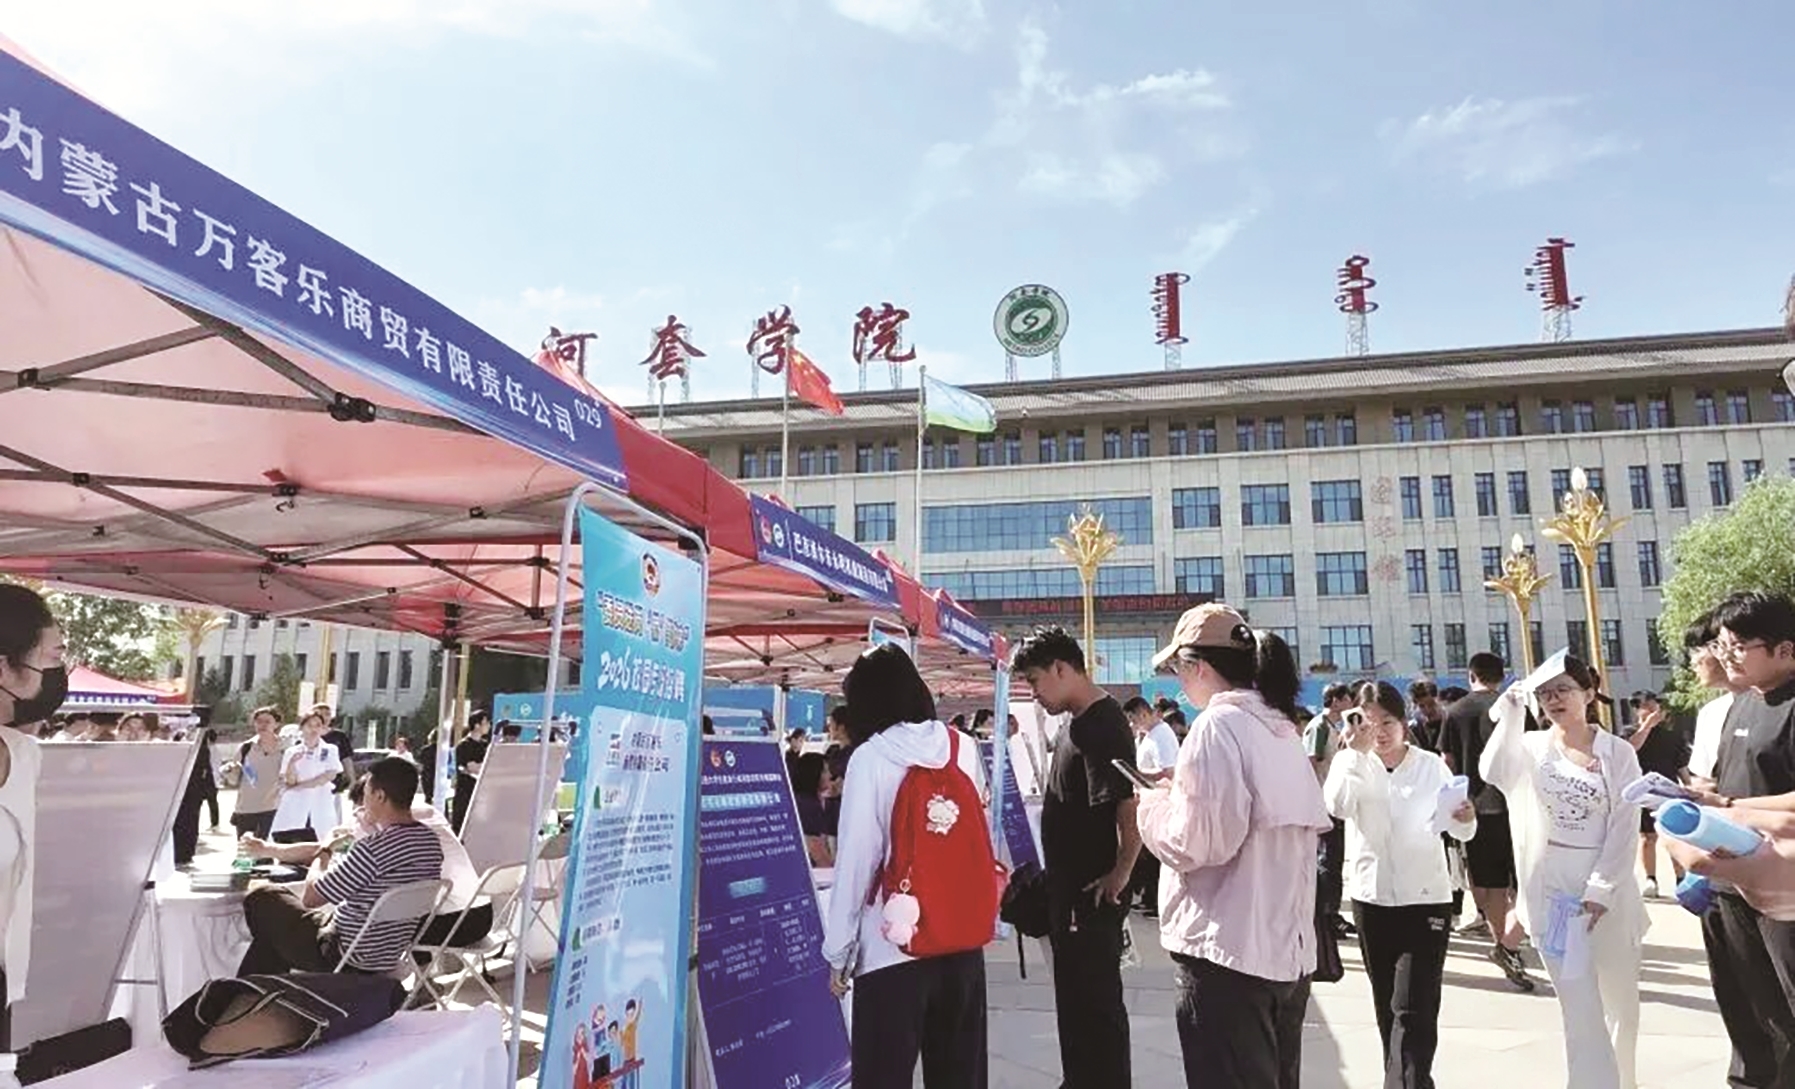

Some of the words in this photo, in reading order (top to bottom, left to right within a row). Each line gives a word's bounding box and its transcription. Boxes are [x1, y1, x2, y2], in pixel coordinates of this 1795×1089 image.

[0, 107, 575, 442] 内蒙古万客乐商贸有限责任公司
[574, 399, 602, 428] 029
[541, 302, 917, 381] 河套学院
